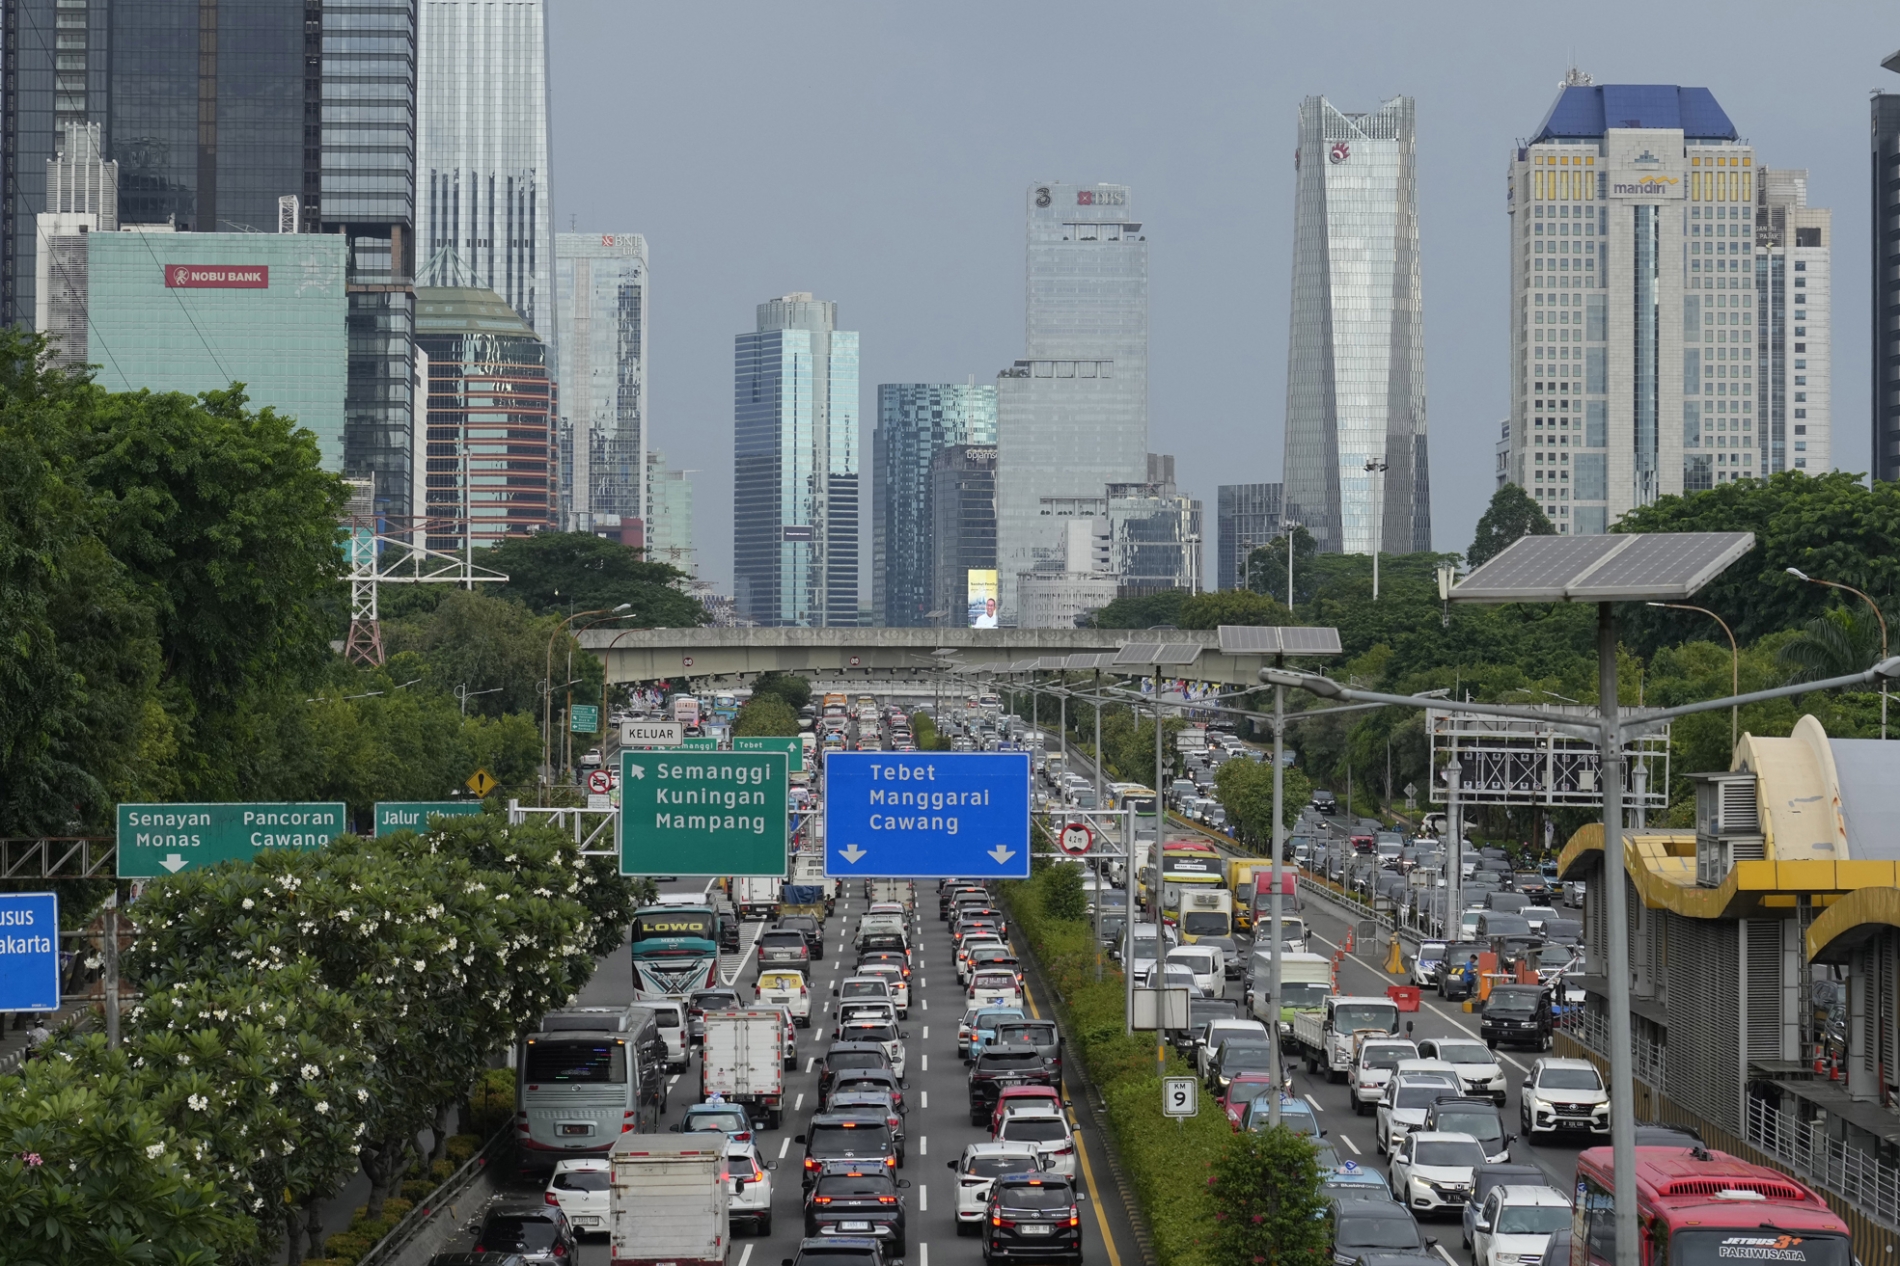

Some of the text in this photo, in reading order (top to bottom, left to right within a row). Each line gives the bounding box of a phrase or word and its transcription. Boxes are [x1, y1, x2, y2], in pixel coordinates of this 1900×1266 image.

[1614, 181, 1666, 194] mandiri
[1035, 187, 1051, 208] 3
[1095, 193, 1123, 204] DBS
[615, 235, 638, 247] BNI
[623, 247, 639, 255] Life
[191, 272, 262, 282] NOBU BANK
[629, 729, 674, 739] KELUAR
[739, 741, 763, 749] Tebet
[657, 763, 771, 785] Semanggi
[870, 764, 935, 781] Tebet
[657, 788, 765, 809] Kuningan
[869, 789, 989, 811] Manggarai
[129, 812, 211, 829] Senayan
[243, 811, 334, 825] Pancoran
[382, 810, 420, 825] Jalur
[656, 813, 765, 834] Mampang
[869, 814, 959, 835] Cawang
[136, 832, 201, 847] Monas
[250, 832, 329, 847] Cawang
[643, 923, 703, 932] LOWO
[1174, 1091, 1186, 1107] 9
[1719, 1246, 1806, 1262] PARIWISATA
